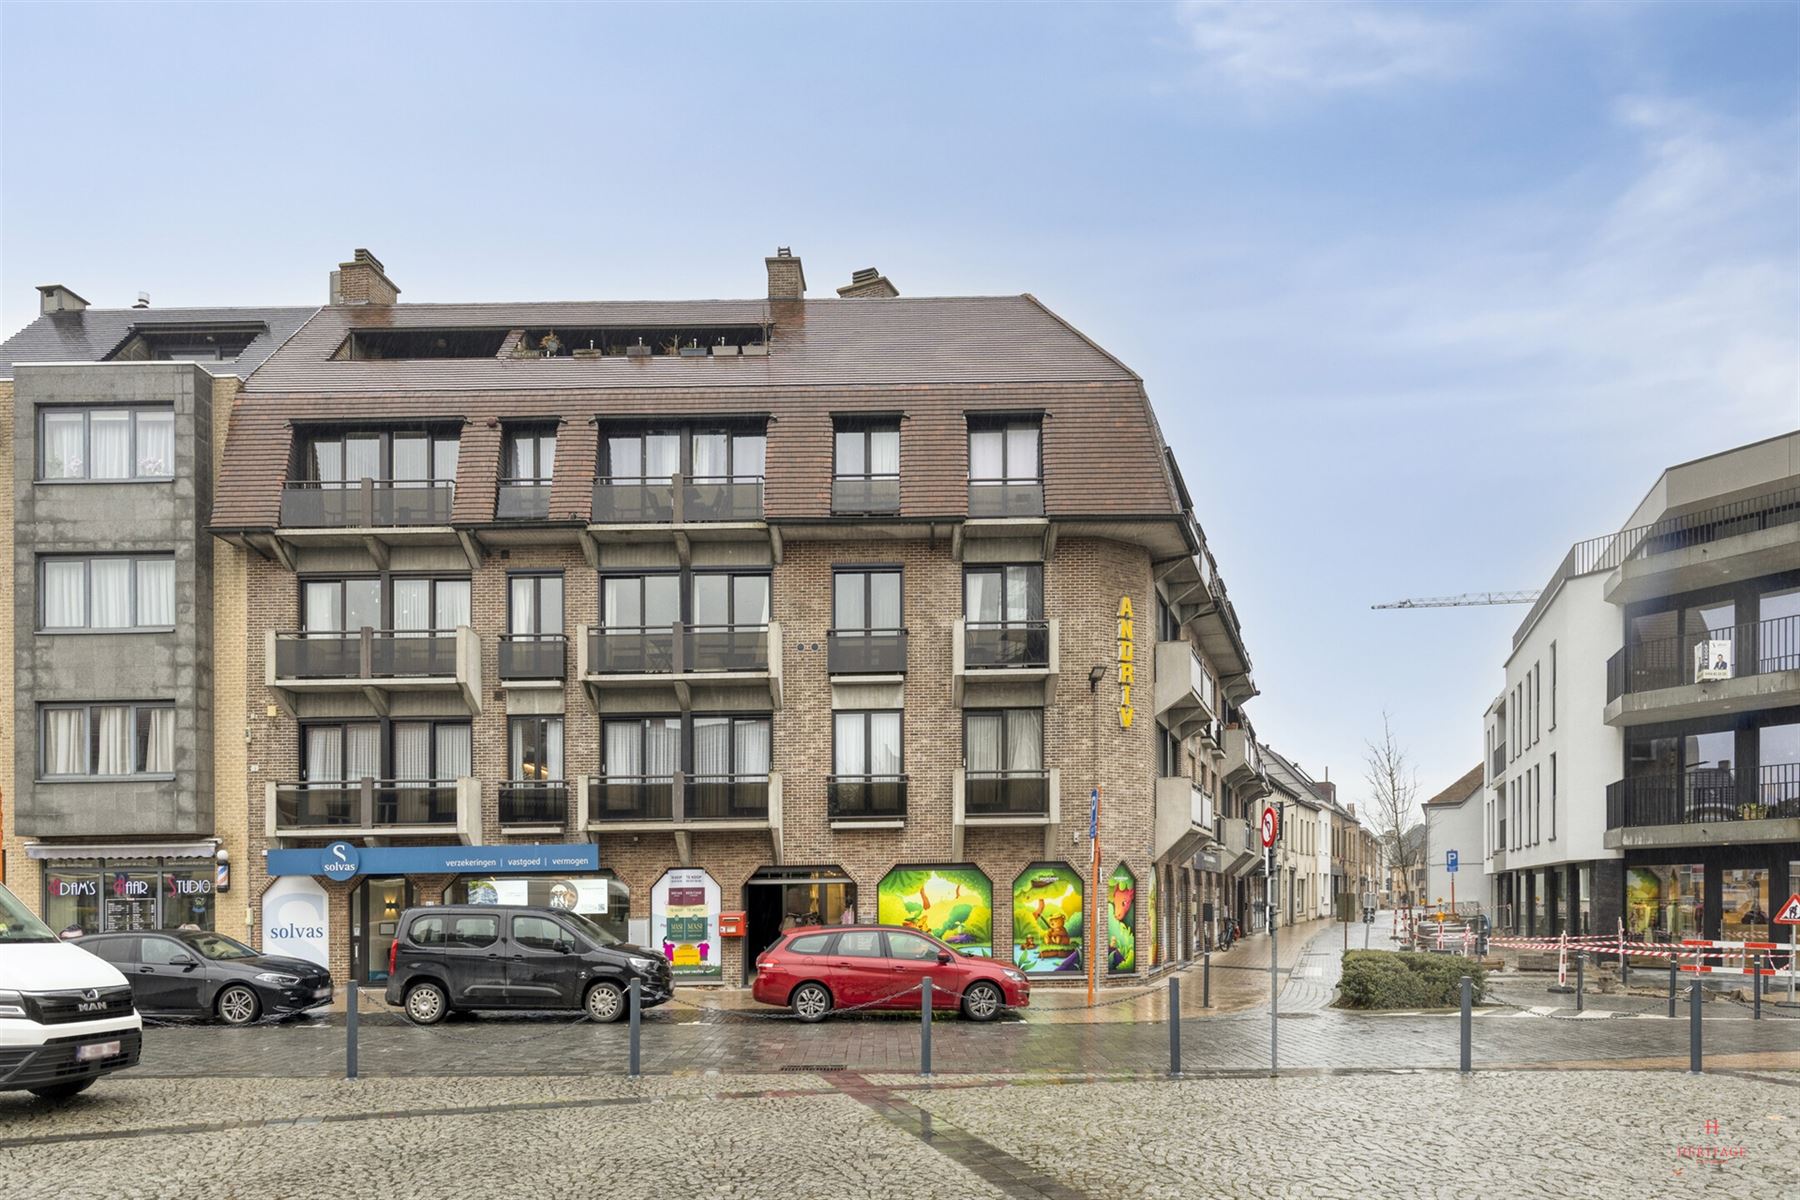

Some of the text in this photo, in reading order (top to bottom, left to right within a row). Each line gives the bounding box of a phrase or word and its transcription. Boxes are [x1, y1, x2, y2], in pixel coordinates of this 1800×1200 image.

[446, 857, 589, 867] verzekeringen vastgoed vermogen
[1448, 852, 1457, 865] P
[323, 862, 356, 872] solvas
[168, 876, 211, 897] STUDIO
[270, 923, 324, 939] solvas
[78, 1001, 107, 1012] MAN
